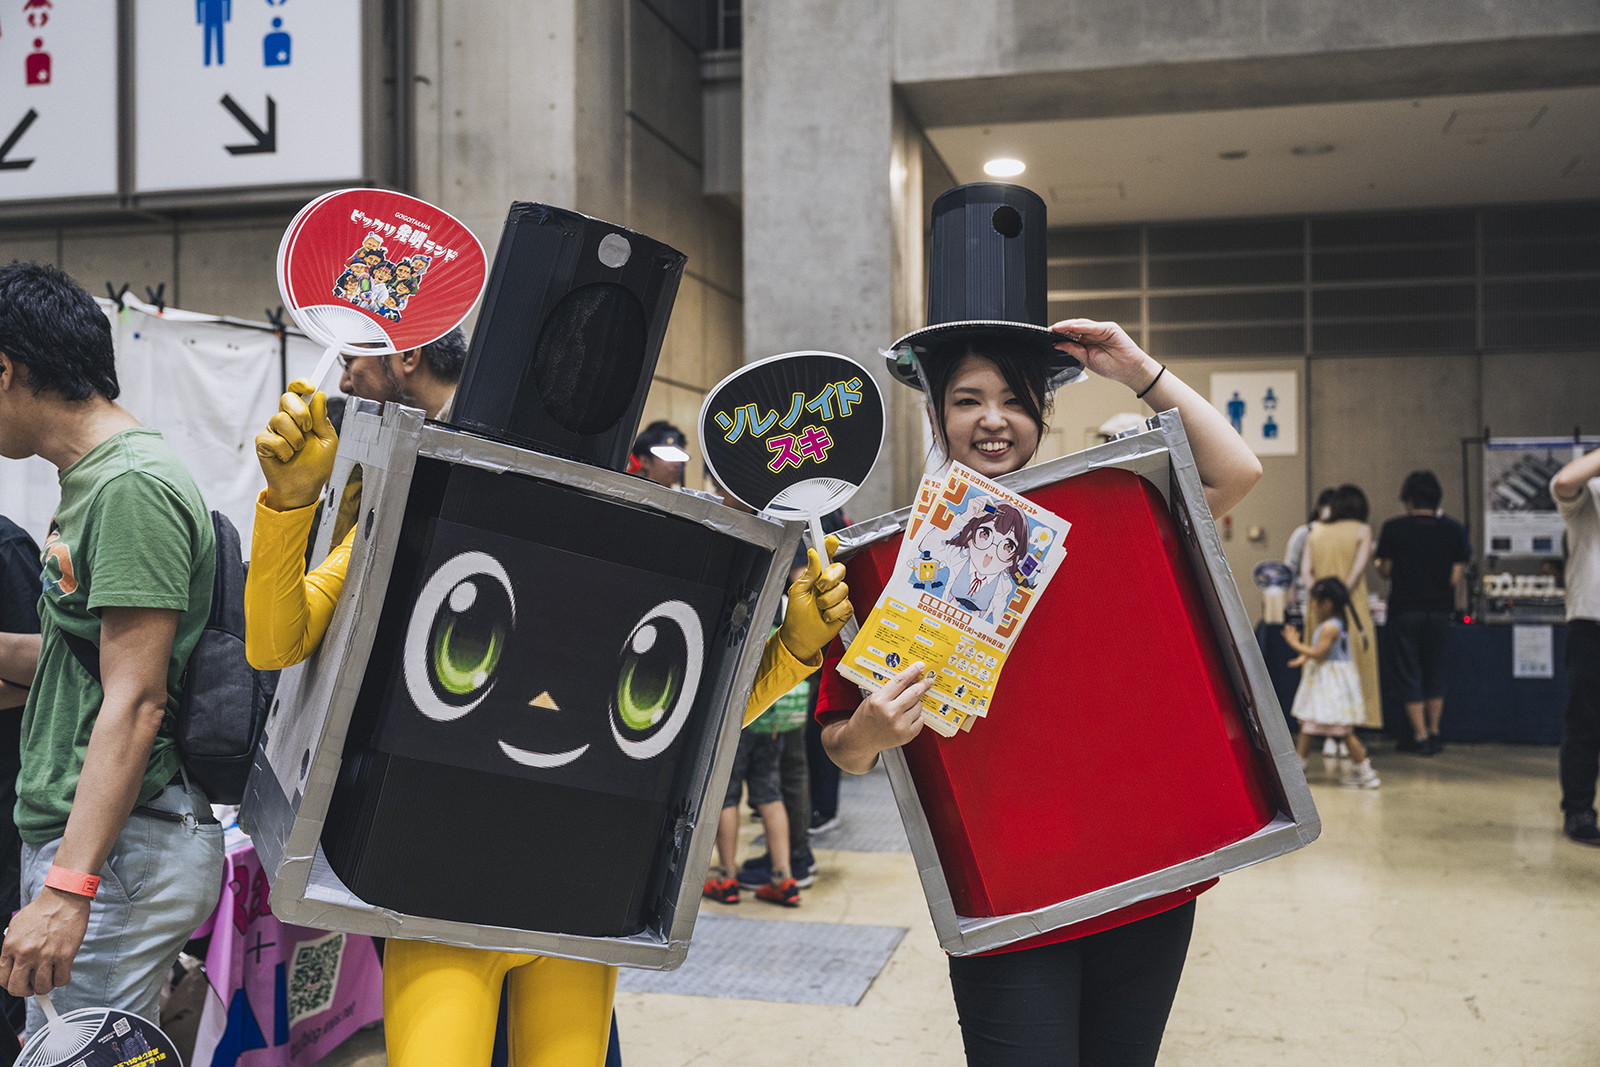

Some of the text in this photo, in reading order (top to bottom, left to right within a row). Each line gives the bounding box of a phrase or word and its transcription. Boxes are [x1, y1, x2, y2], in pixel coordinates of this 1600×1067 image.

[350, 209, 459, 263] ビックリ発明ランド
[714, 377, 863, 444] ソレノイド
[766, 424, 834, 473] スキ
